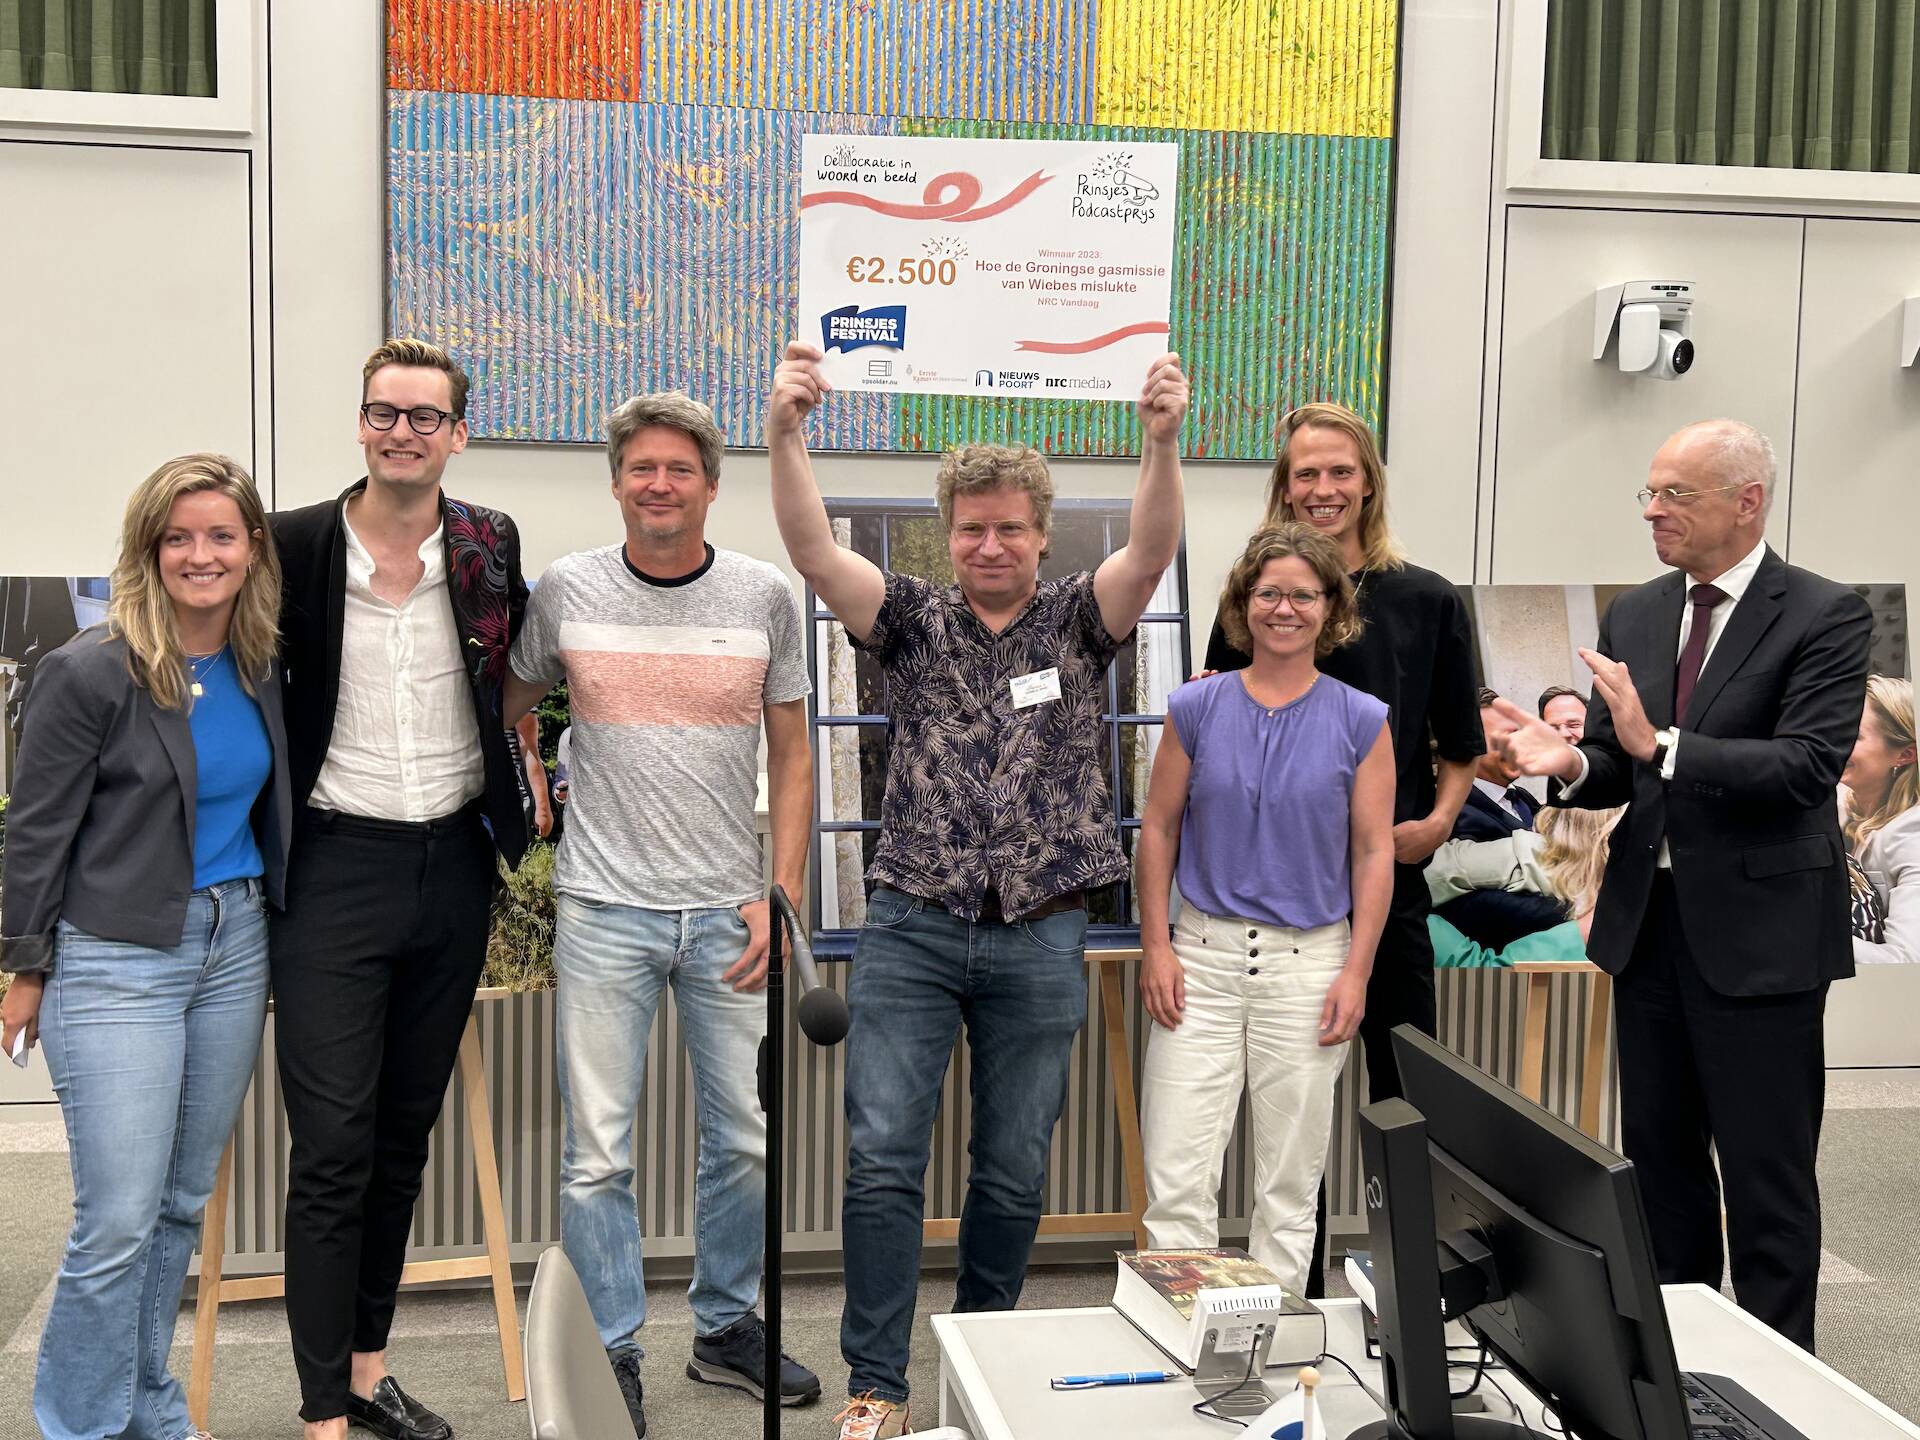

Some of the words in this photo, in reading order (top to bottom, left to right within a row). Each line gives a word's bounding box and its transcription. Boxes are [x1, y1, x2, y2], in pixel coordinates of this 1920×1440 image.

[901, 159, 912, 169] in
[863, 174, 877, 183] en
[884, 170, 917, 184] beeld
[1038, 249, 1075, 258] Winnaar
[846, 256, 957, 286] €2.500
[975, 260, 1001, 272] Hoe
[1005, 261, 1022, 272] de
[1025, 261, 1095, 277] Groningse
[1098, 264, 1166, 278] gasmissie
[1001, 279, 1025, 290] van
[1028, 278, 1077, 291] Wiebes
[1081, 281, 1137, 293] mislukte
[1037, 297, 1058, 306] NRC
[1060, 299, 1100, 309] Vandaag
[830, 316, 898, 330] PRINSJES
[830, 328, 899, 341] FESTIVAL
[999, 371, 1040, 381] NIEUWS
[999, 380, 1033, 389] POORT
